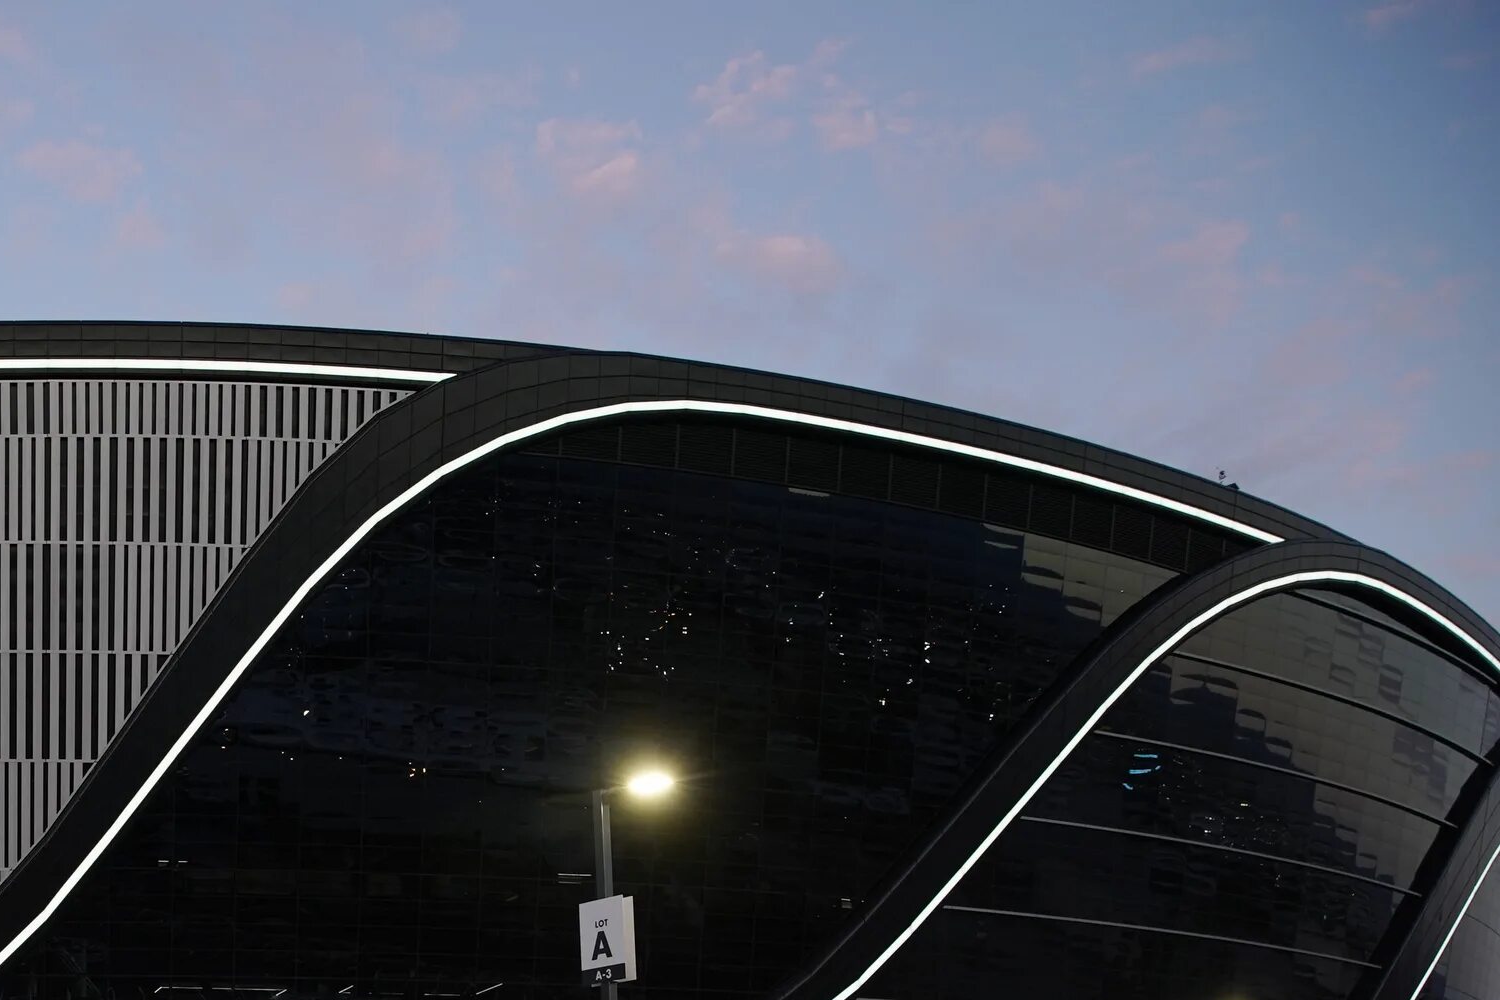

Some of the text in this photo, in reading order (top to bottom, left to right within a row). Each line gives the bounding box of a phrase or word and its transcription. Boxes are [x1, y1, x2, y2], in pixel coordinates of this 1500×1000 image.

[595, 919, 608, 928] LOT
[592, 930, 613, 961] A
[595, 968, 612, 981] A-3
